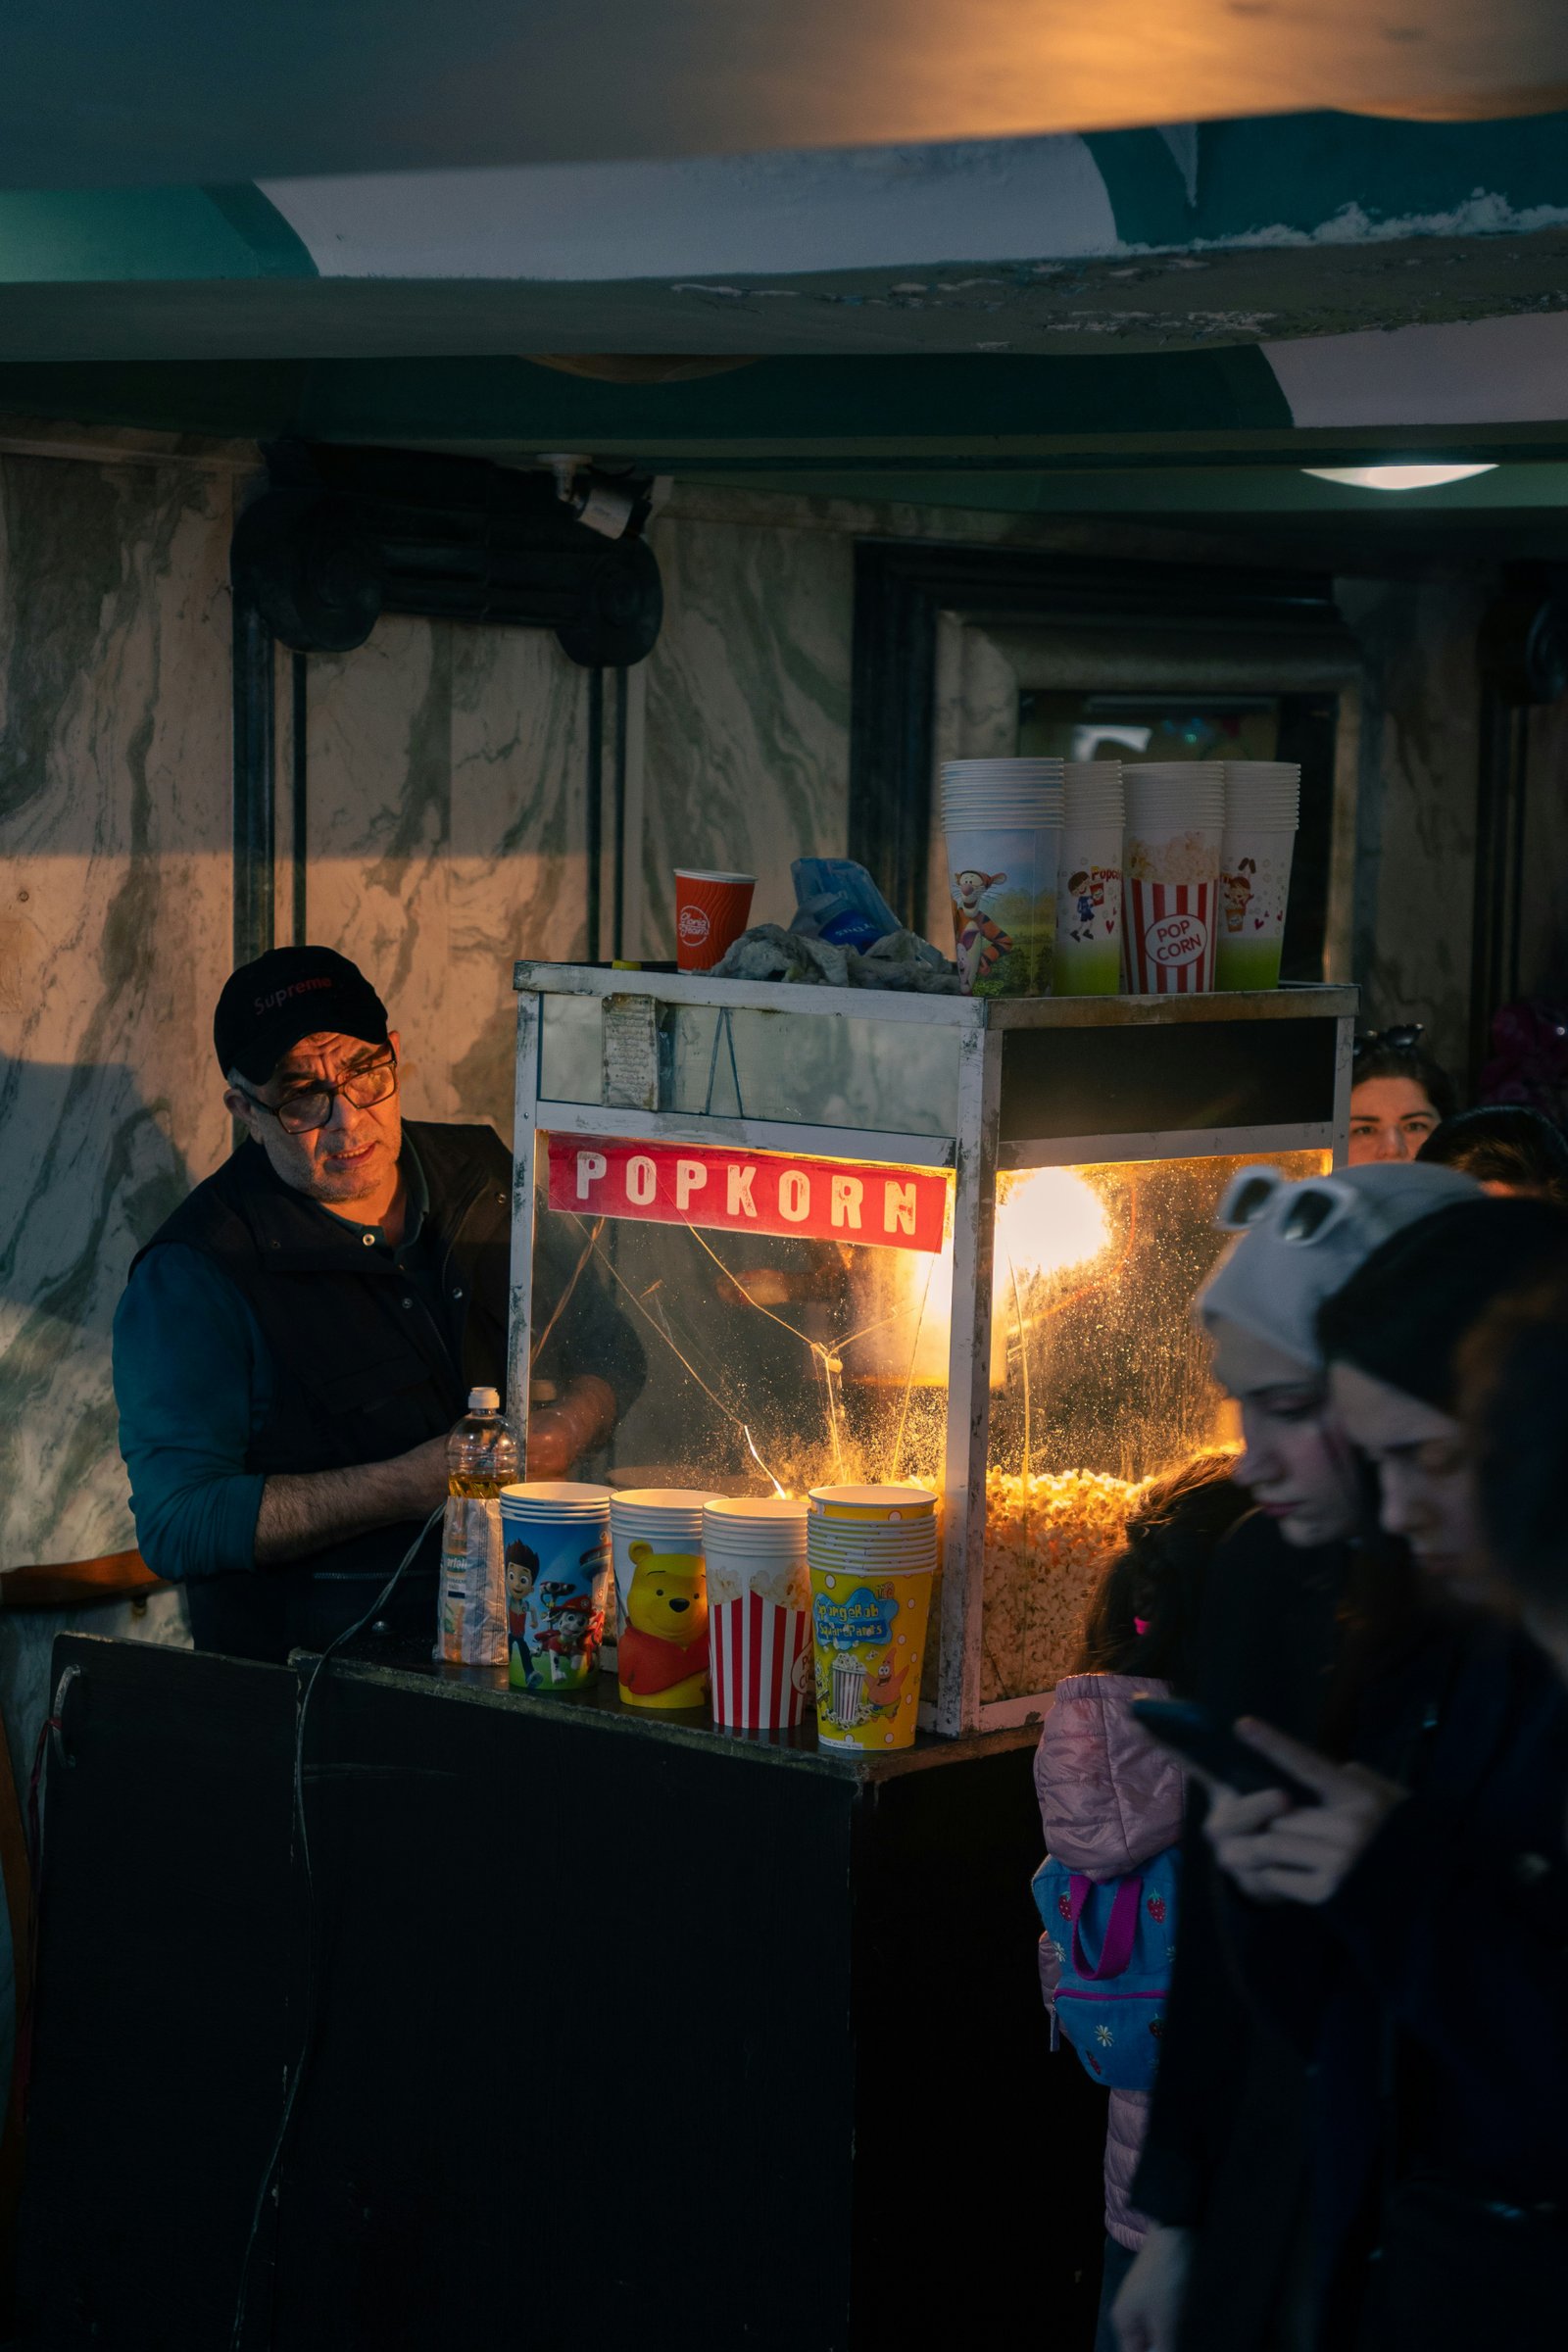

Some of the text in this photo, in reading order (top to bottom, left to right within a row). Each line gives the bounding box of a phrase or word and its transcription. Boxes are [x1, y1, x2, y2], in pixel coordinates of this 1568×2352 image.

[1156, 919, 1190, 943] POP
[1156, 933, 1202, 961] CORN
[253, 976, 334, 1016] Supreme
[575, 1150, 917, 1236] POPKORN
[816, 1598, 879, 1622] SpongeBob
